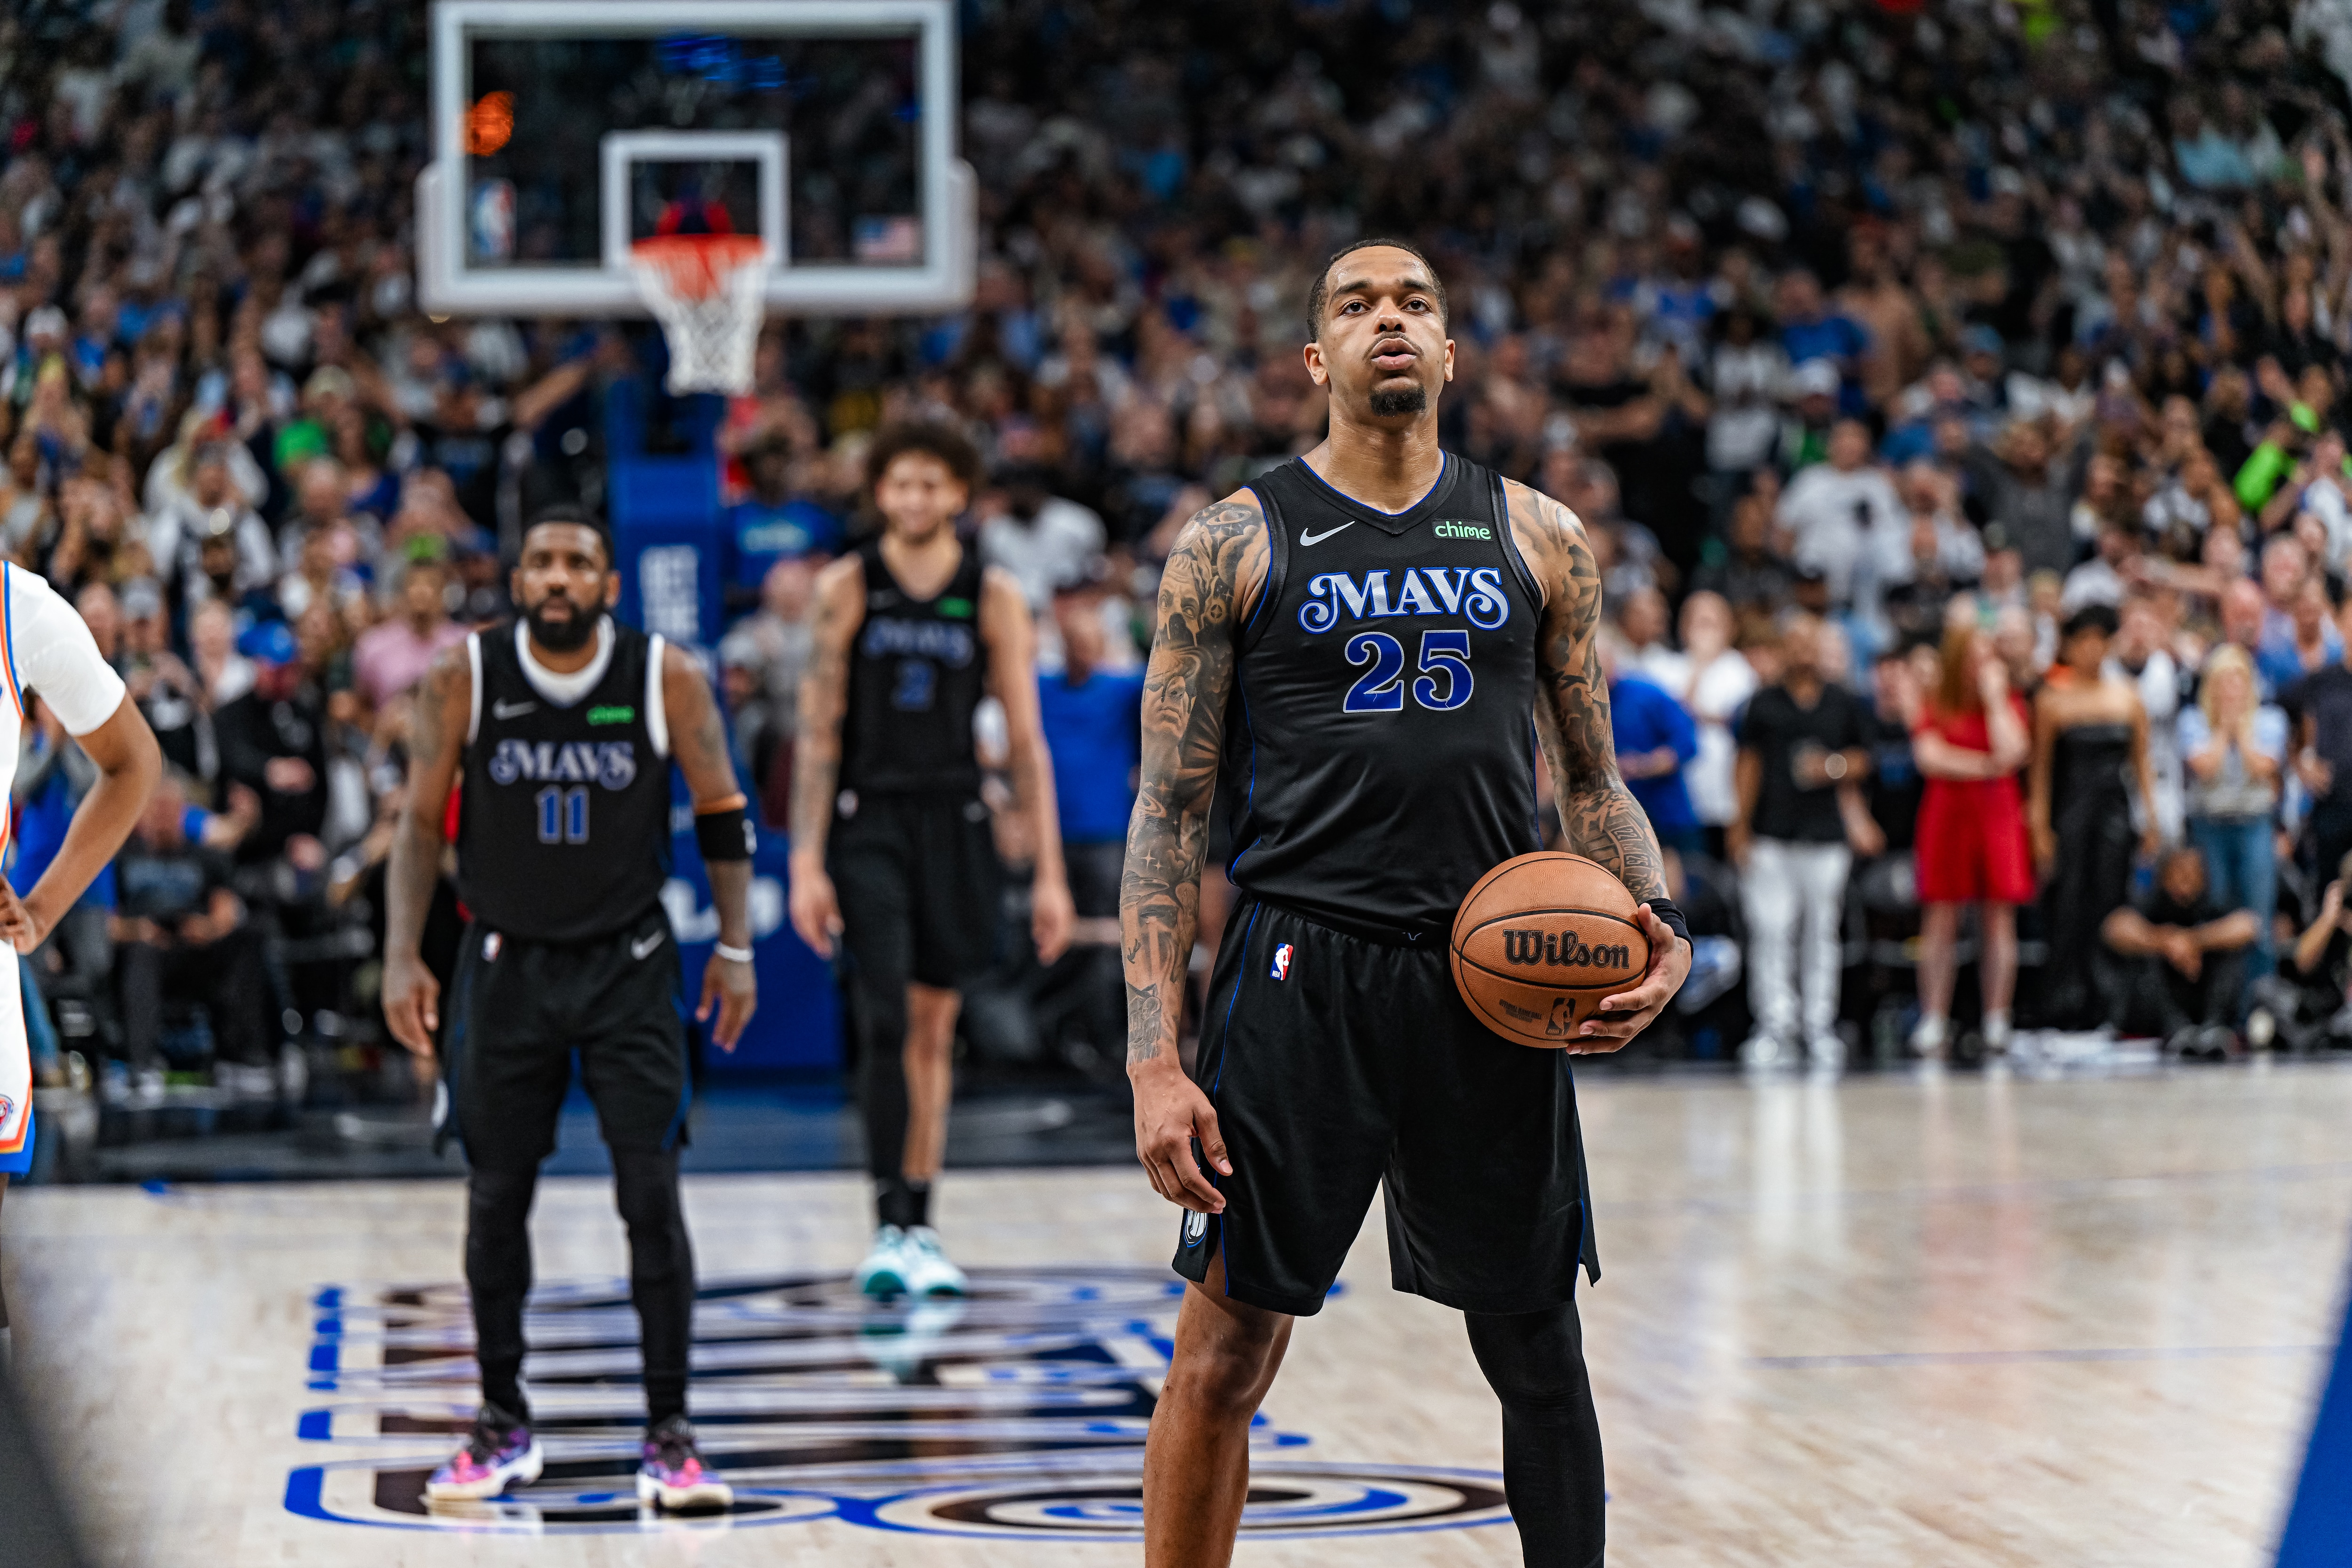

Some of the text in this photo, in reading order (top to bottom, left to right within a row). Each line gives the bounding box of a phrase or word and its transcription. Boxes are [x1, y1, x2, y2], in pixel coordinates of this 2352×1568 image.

[1435, 521, 1491, 540] chime
[1298, 567, 1510, 633] MAVS
[1343, 630, 1474, 713] 25
[488, 739, 637, 791] MAVS
[535, 785, 590, 844] 11
[1503, 930, 1629, 969] Wilson
